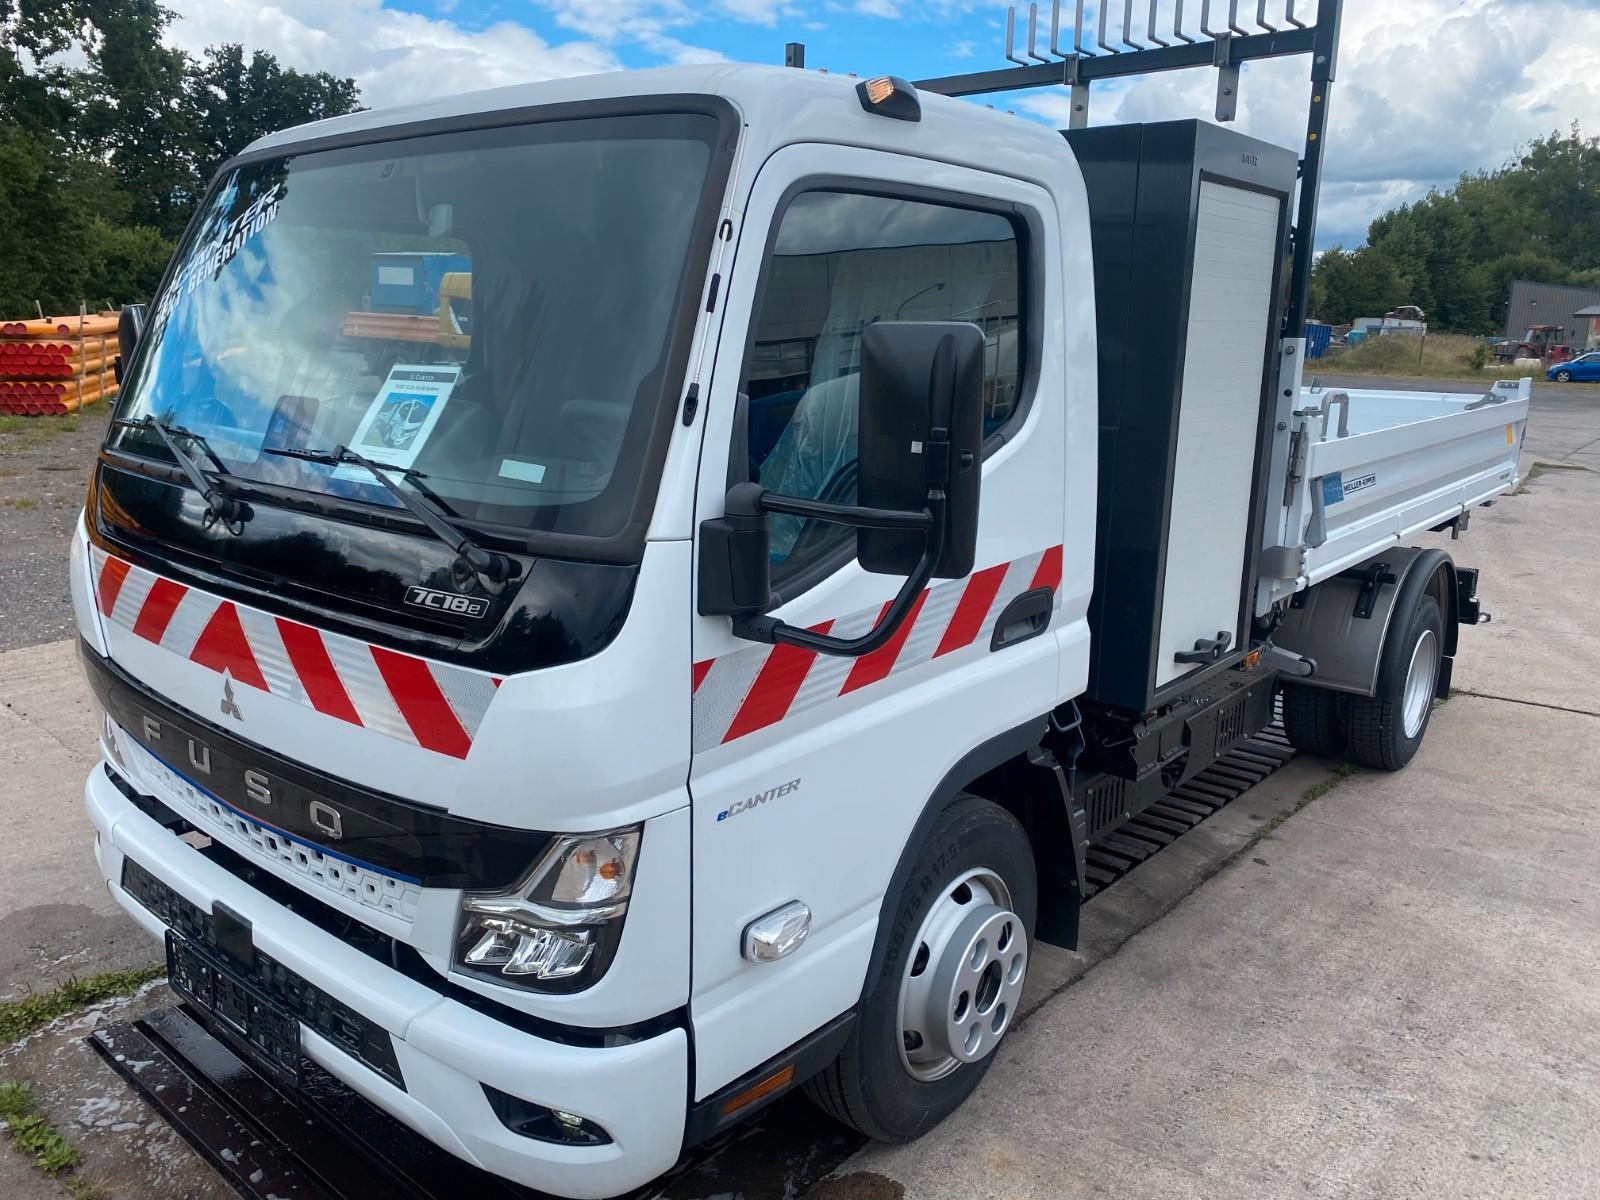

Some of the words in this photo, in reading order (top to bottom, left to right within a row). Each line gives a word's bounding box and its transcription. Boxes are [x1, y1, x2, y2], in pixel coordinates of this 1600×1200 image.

[188, 201, 279, 295] GENERATION
[143, 715, 343, 841] FUSO
[716, 778, 801, 822] eCANTER
[920, 873, 933, 893] R
[932, 843, 958, 875] 17.5
